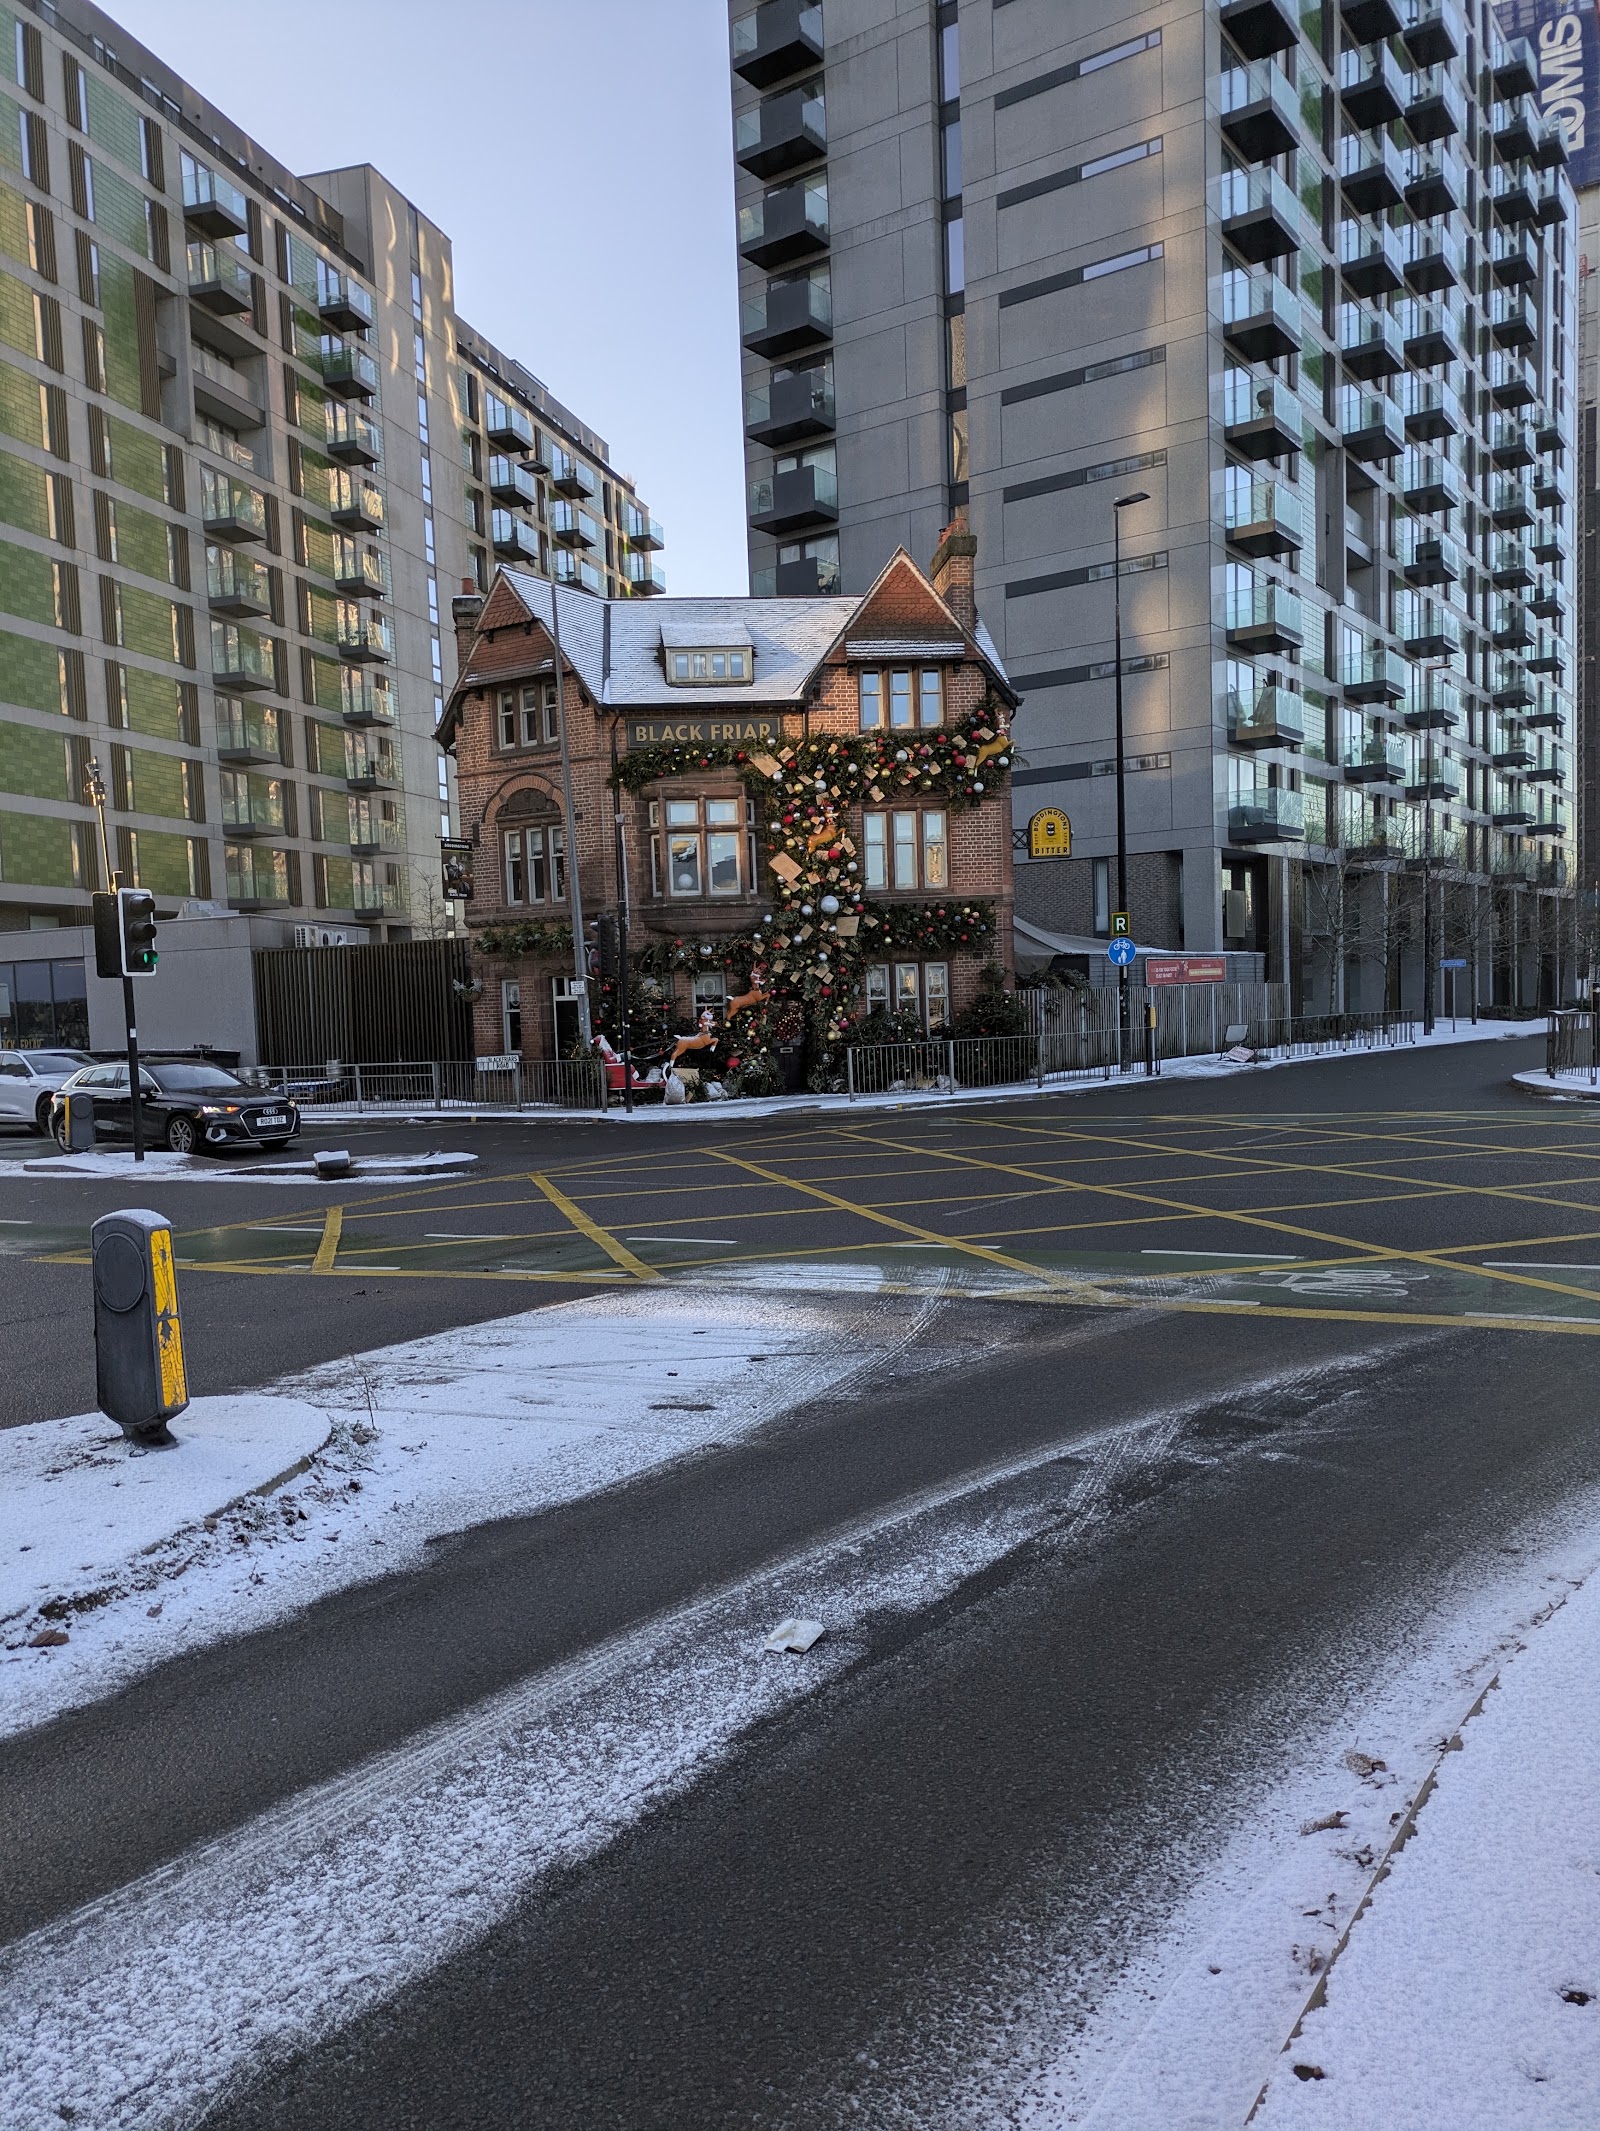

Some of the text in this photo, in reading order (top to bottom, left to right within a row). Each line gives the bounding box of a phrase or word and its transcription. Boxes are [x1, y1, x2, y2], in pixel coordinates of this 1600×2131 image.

[635, 723, 771, 742] BLACK FRIAR
[1033, 810, 1068, 832] BODDINGTONS
[1035, 847, 1068, 855] BITTER
[1115, 917, 1126, 931] R
